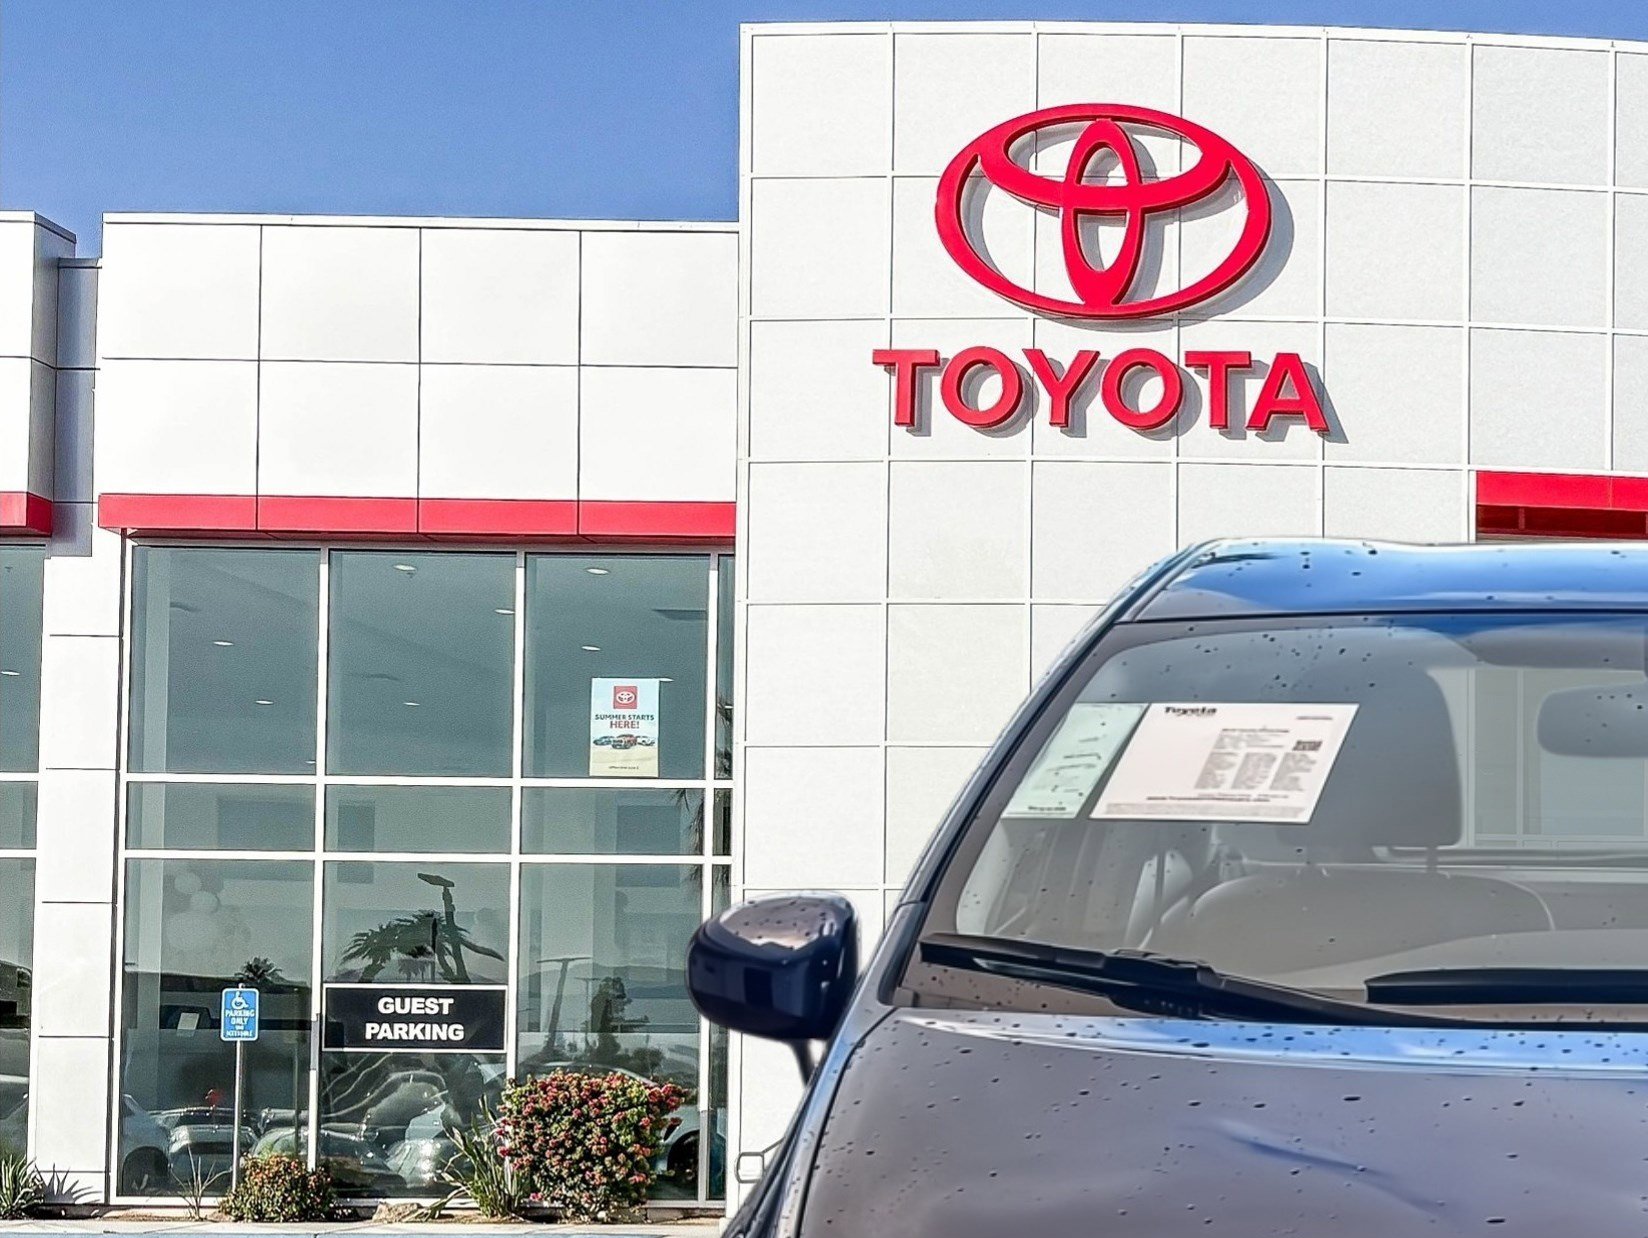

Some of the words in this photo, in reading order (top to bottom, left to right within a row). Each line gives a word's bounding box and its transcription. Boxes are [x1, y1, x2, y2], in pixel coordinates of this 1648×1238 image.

[872, 345, 1331, 432] TOYOTA
[610, 721, 640, 729] HERE!
[377, 996, 455, 1015] GUEST
[365, 1022, 465, 1041] PARKING
